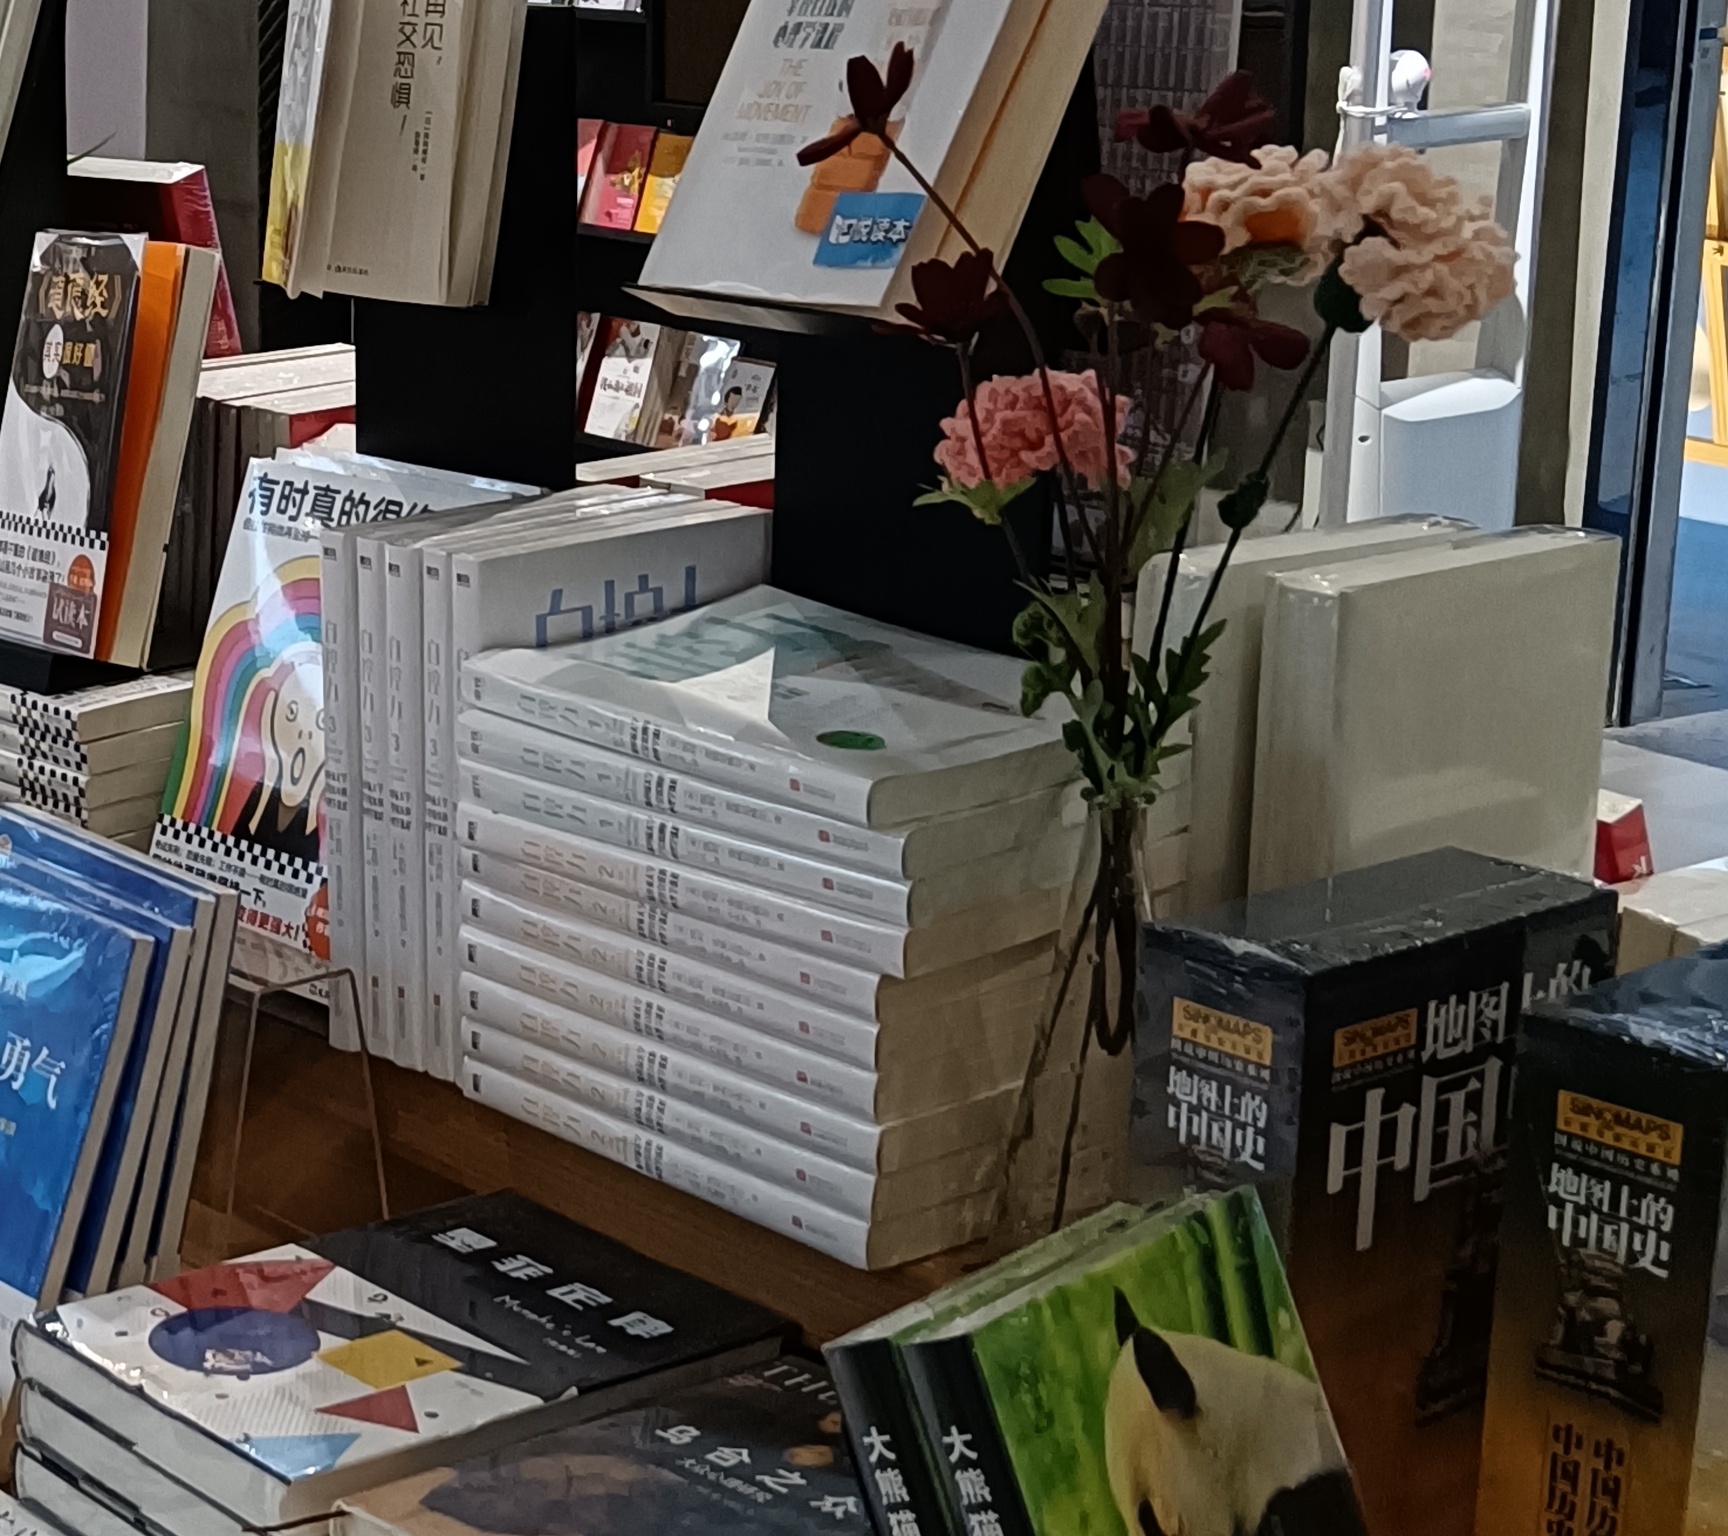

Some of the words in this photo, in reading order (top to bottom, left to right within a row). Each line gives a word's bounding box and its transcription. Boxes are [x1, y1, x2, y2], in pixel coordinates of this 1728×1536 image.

[1167, 1064, 1268, 1128] 地图上的
[1167, 1101, 1267, 1174] 中国史
[1547, 1160, 1675, 1231] 地图上的
[1547, 1203, 1673, 1280] 中国史
[654, 1424, 861, 1520] 乌合之众
